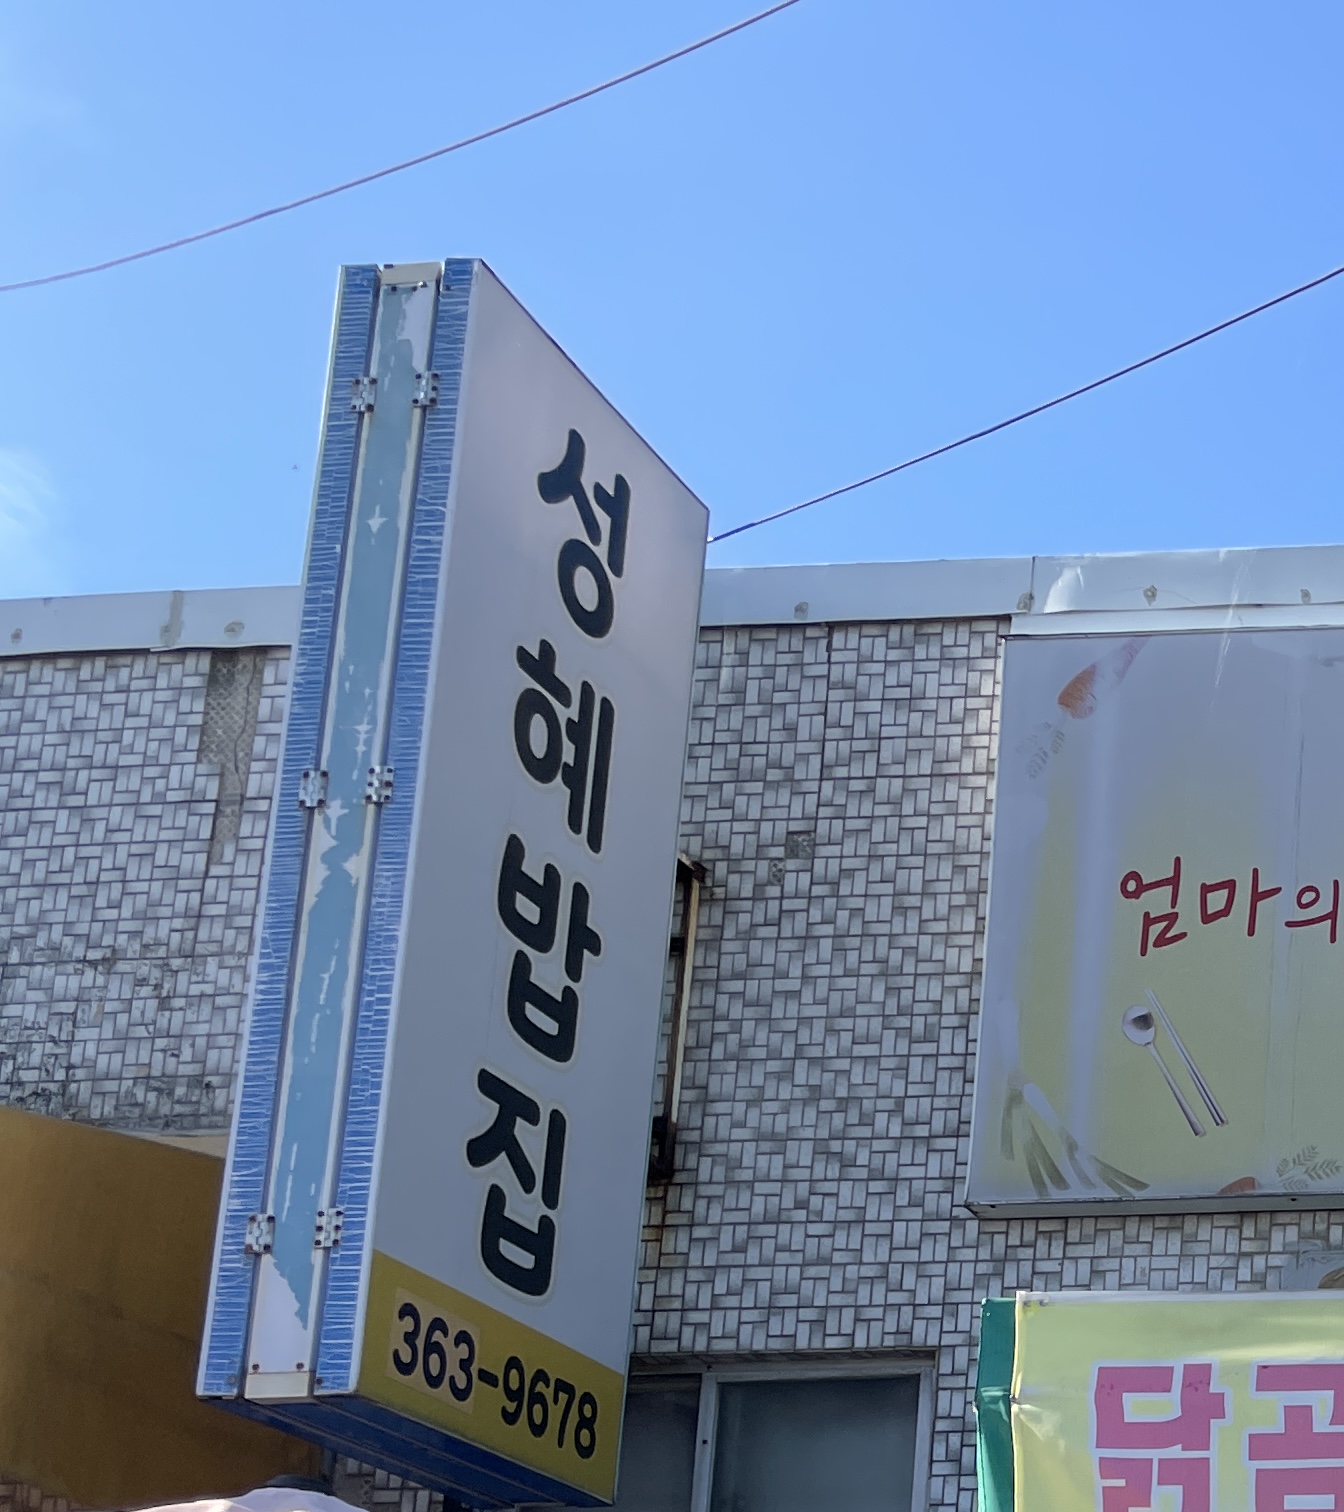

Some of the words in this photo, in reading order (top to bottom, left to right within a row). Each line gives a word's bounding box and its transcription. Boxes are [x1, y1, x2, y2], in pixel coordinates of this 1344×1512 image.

[465, 427, 630, 1298] 성혜밥집
[1119, 857, 1341, 957] 엄마의
[392, 1302, 599, 1461] 363-9678
